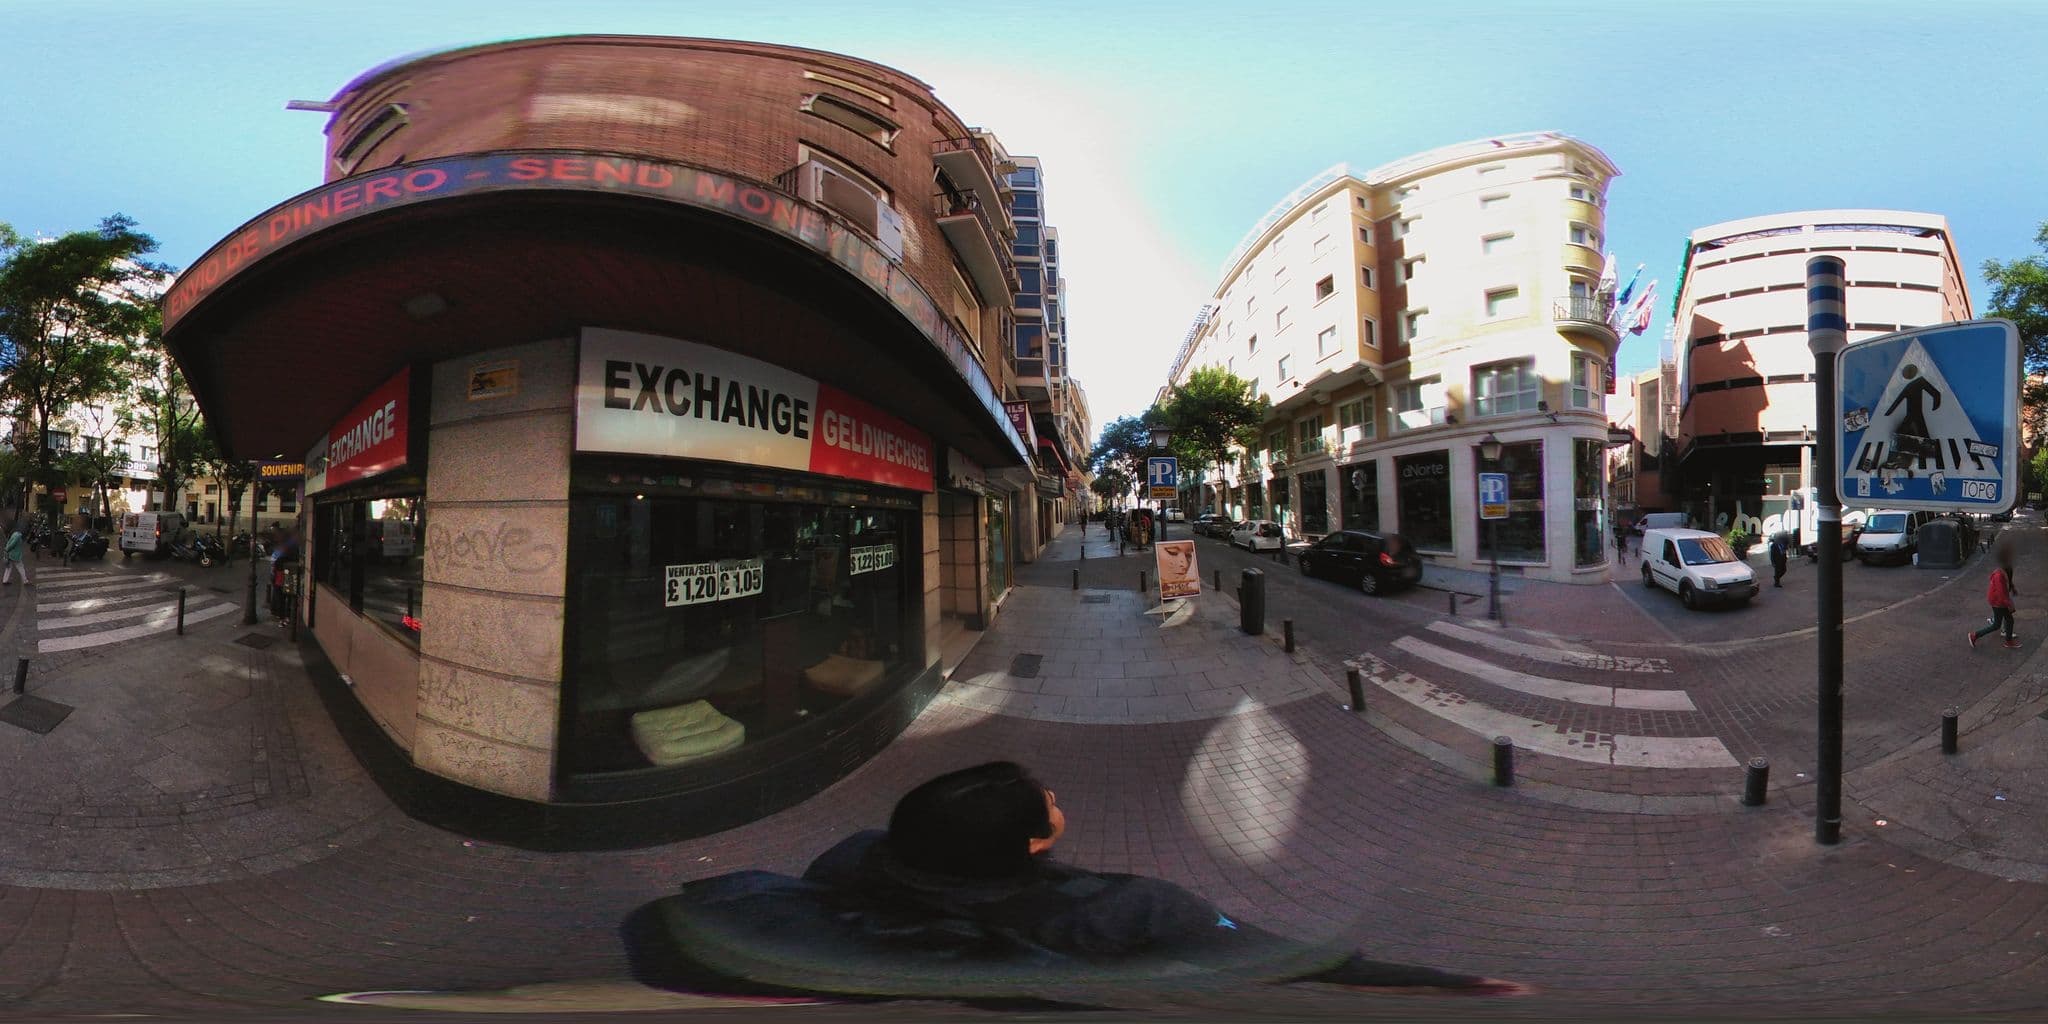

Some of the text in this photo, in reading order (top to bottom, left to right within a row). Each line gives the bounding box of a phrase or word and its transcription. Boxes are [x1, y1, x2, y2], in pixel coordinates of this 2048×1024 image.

[171, 260, 221, 316] ENVIO
[225, 233, 260, 270] DE
[269, 168, 447, 244] DINERO
[509, 158, 673, 188] SEND
[696, 174, 848, 250] MONEY
[604, 359, 930, 473] EXCHANGE GELDWECHSEL
[330, 399, 396, 469] EXCHANGE
[1154, 462, 1173, 485] P
[1486, 478, 1503, 502] P
[1963, 481, 1996, 499] TOPO
[668, 564, 717, 578] VENTA/SELL
